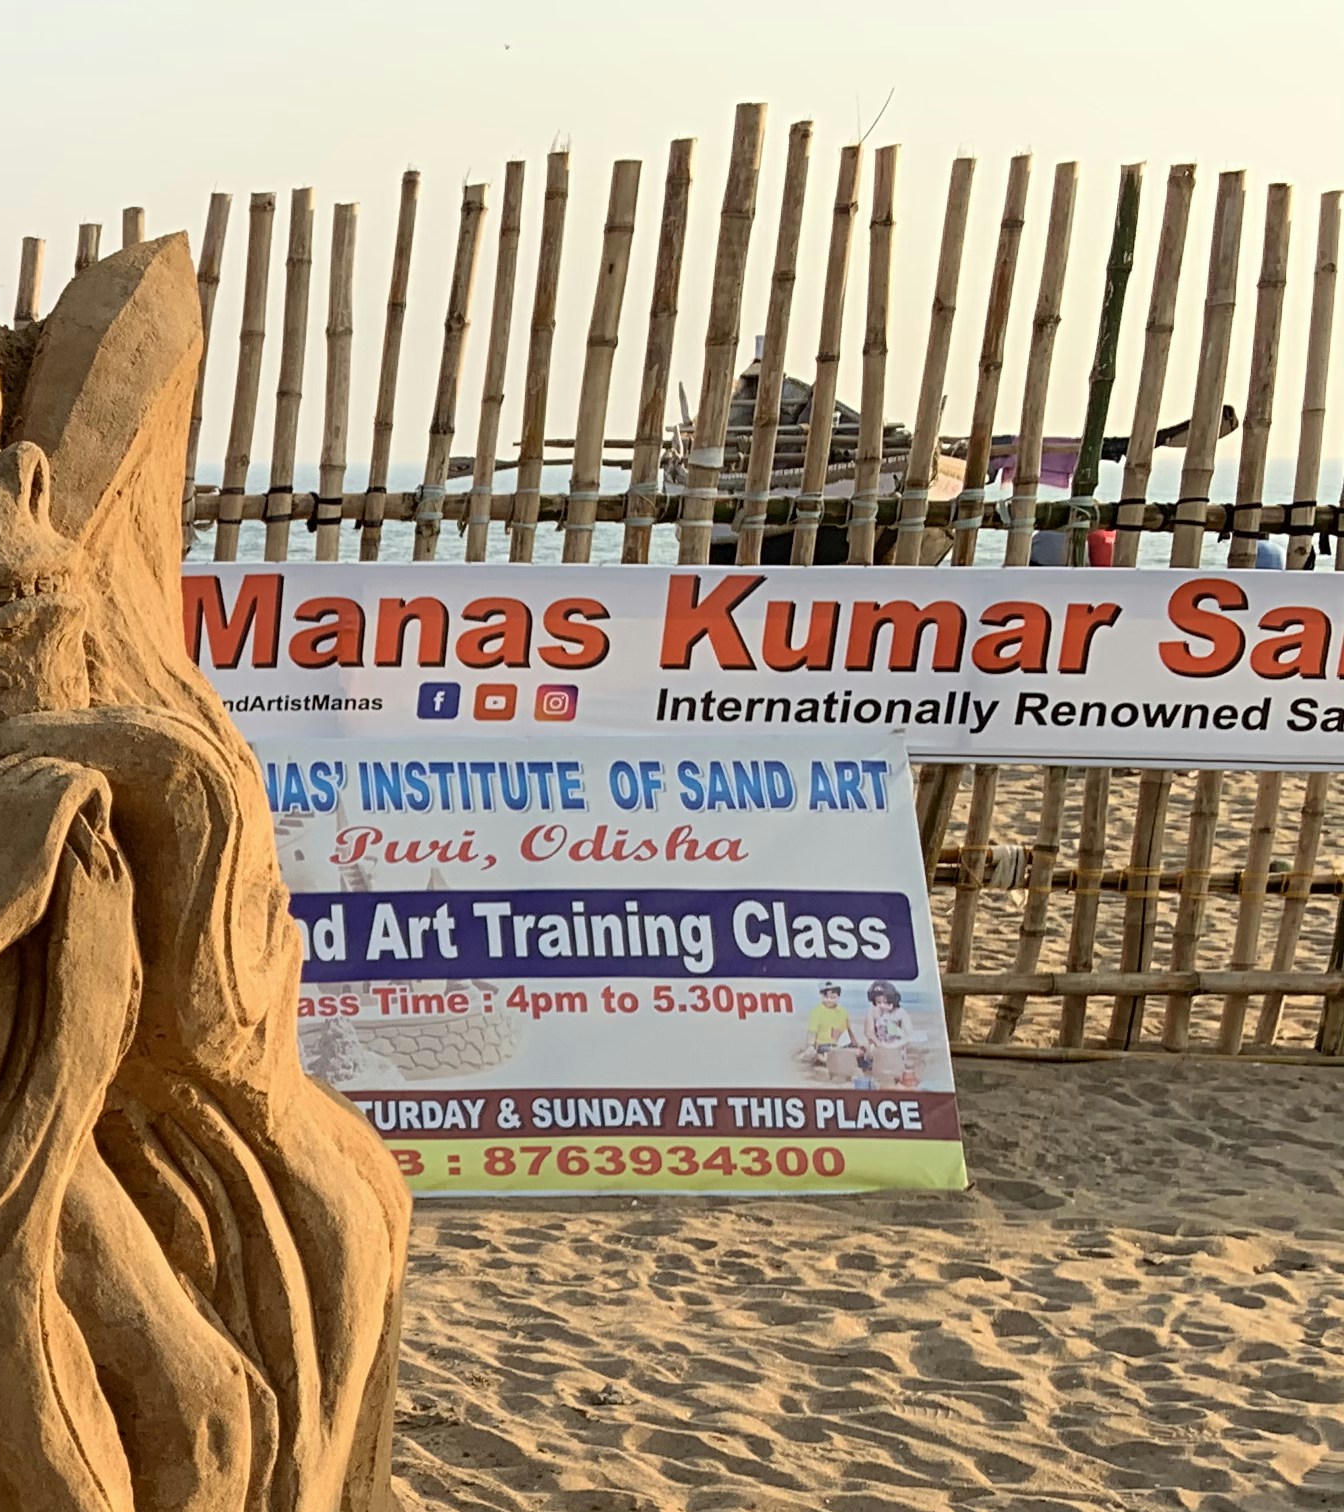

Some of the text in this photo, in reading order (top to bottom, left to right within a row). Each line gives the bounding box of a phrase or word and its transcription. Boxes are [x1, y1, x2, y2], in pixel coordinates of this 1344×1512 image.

[181, 573, 1344, 680] Manas Kumar Sa
[223, 694, 383, 712] ndArtistManas
[656, 689, 1344, 734] Internationally Renowned Sa
[266, 760, 889, 812] NAS' INSTITUTE OF SAND ART
[330, 824, 750, 871] Puri, Odisha
[295, 901, 892, 974] nd Art Training Class
[298, 994, 359, 1017] ass
[372, 987, 469, 1014] Time
[506, 985, 588, 1019] 4pm
[600, 986, 640, 1015] to
[653, 985, 795, 1020] 5.30pm
[356, 1097, 924, 1130] URDAY & SUNDAY AT THIS PLACE
[390, 1148, 425, 1177] B
[482, 1144, 847, 1178] 8763934300
